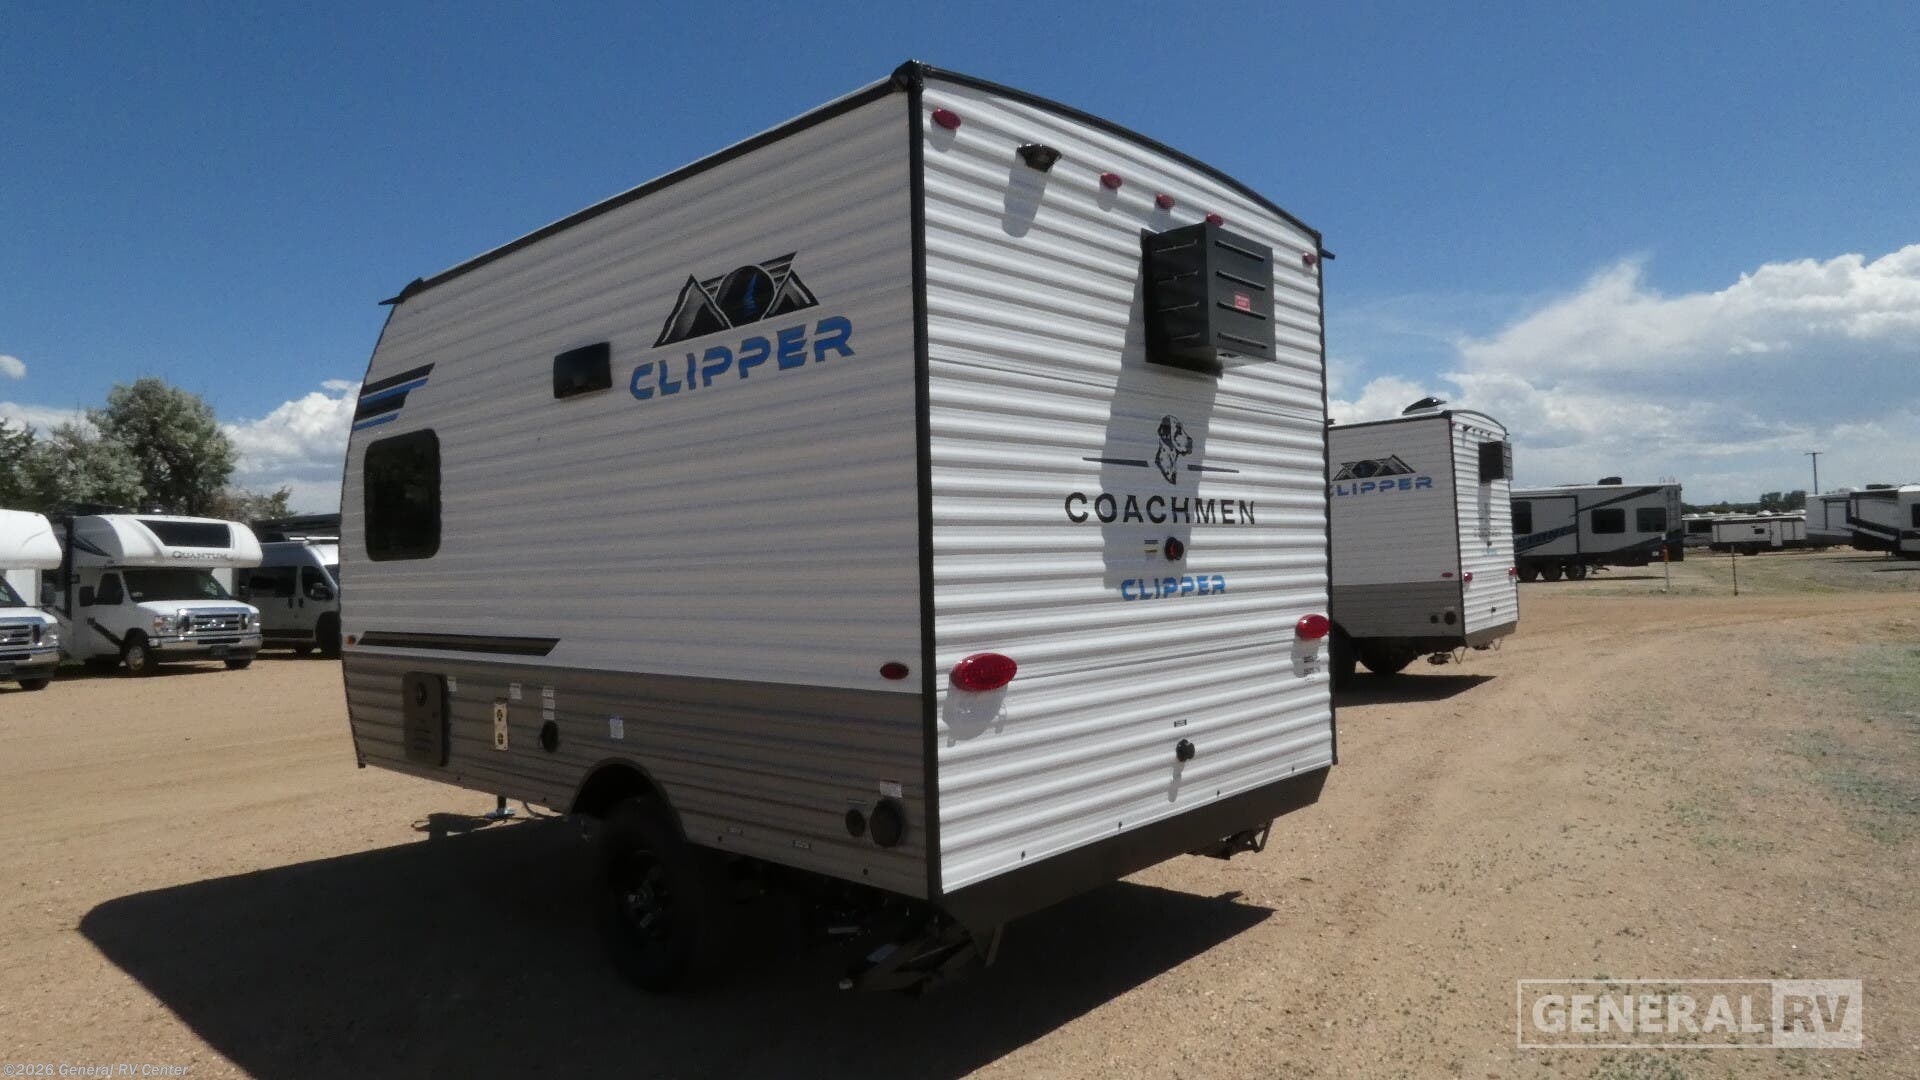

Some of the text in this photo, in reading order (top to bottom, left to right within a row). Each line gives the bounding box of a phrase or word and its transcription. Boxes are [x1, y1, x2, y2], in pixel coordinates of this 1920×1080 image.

[630, 316, 855, 400] CLIPPER
[1065, 492, 1256, 525] COACHMEN
[1120, 575, 1226, 601] CLIPPER
